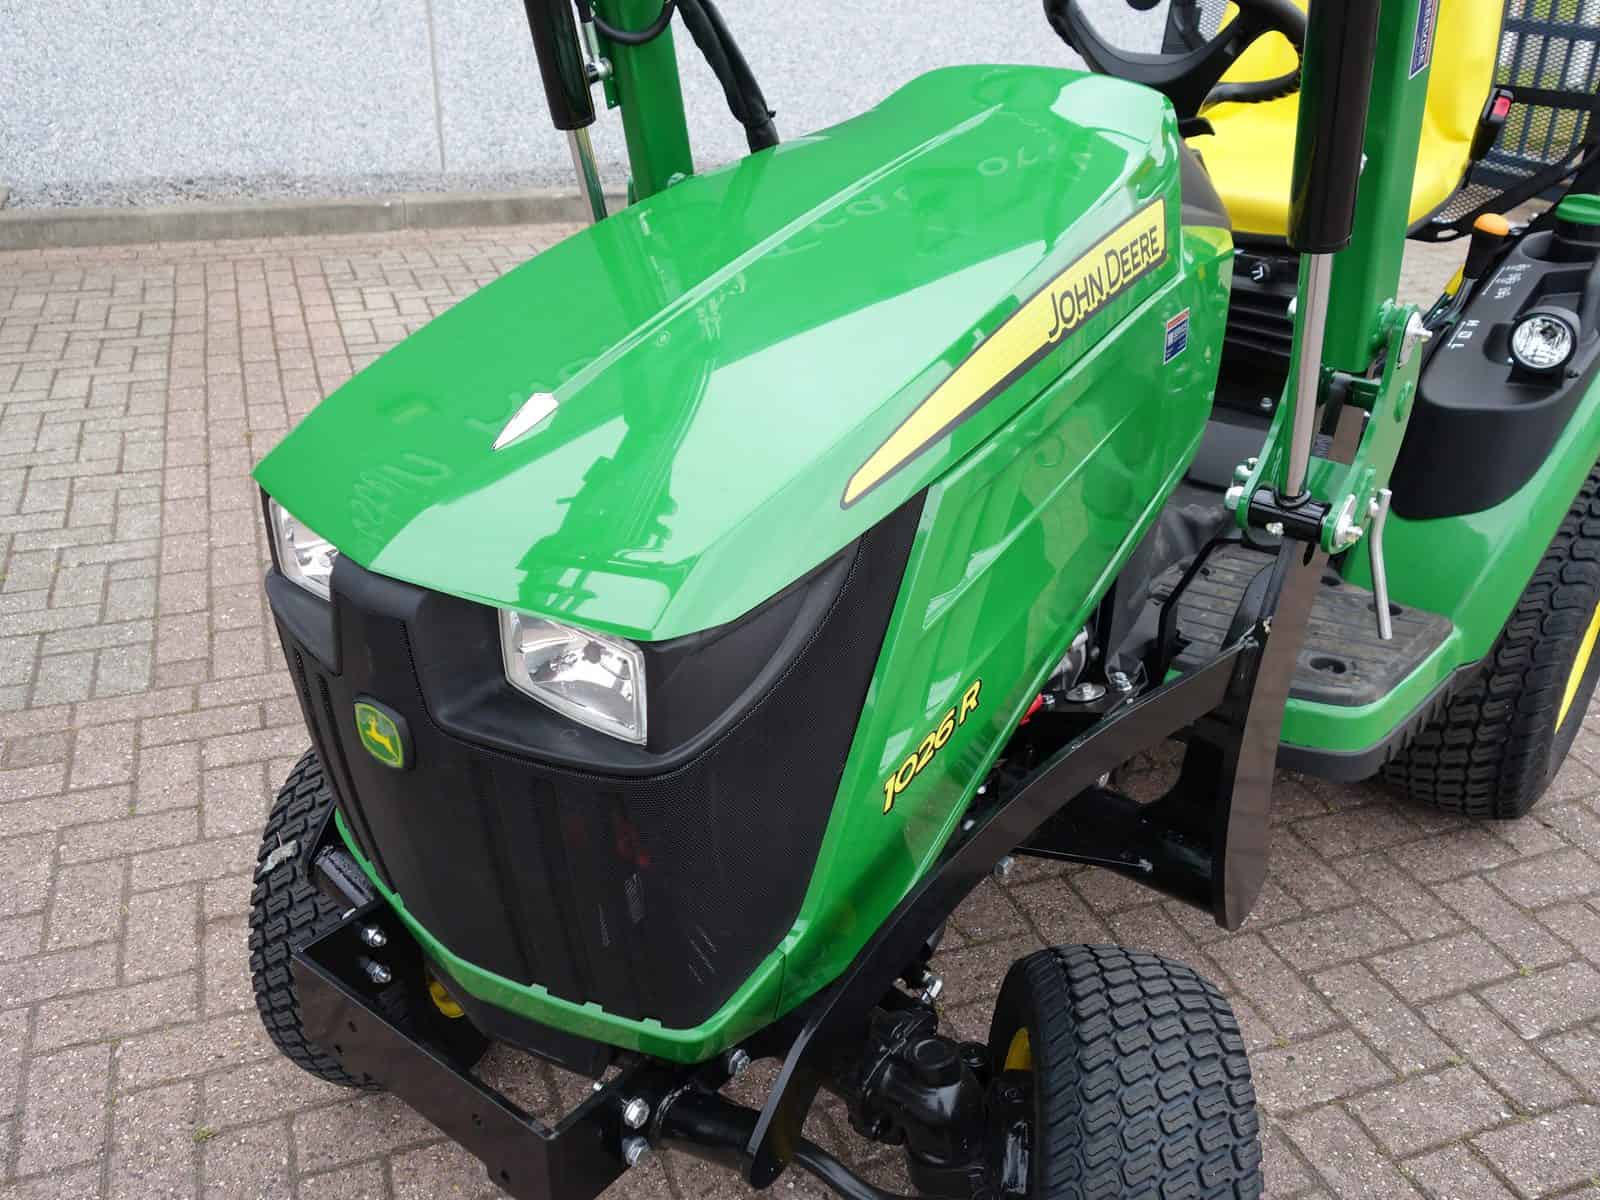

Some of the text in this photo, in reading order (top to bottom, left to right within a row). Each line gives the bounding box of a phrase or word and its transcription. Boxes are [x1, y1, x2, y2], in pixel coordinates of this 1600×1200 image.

[1048, 265, 1104, 339] JOHN
[1104, 225, 1160, 289] DEERE
[882, 679, 982, 815] 1026 R
